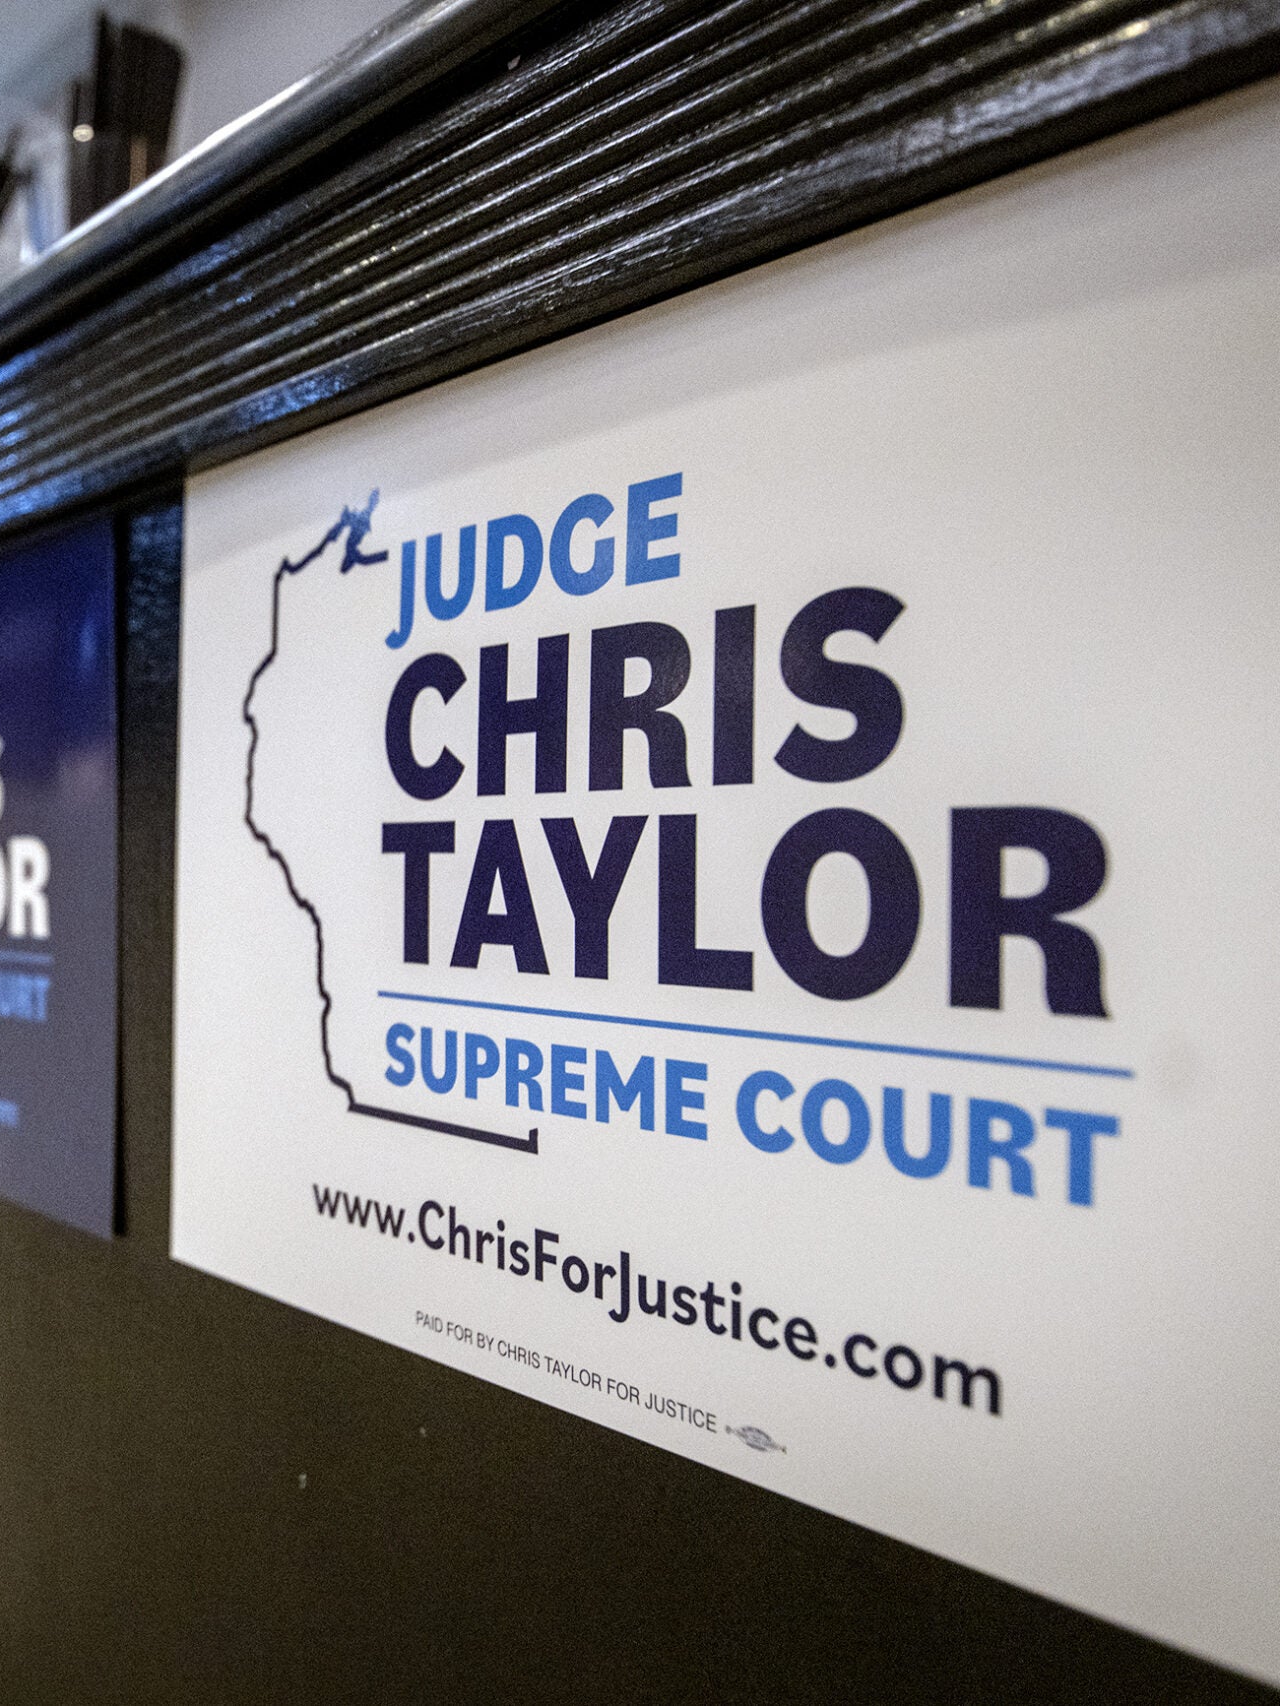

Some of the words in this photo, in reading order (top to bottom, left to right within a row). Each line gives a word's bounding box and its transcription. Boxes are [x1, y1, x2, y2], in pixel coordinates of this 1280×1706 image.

[384, 472, 684, 649] JUDGE
[384, 586, 907, 802] CHRIS
[381, 806, 1111, 1020] TAYLOR
[384, 1022, 709, 1142] SUPREME
[735, 1070, 1120, 1207] COURT
[312, 1183, 1003, 1417] www.ChrisForJustice.com
[415, 1310, 444, 1334] PAID
[447, 1321, 474, 1345] FOR
[476, 1332, 495, 1352] BY
[497, 1340, 541, 1369] CHRIS
[544, 1355, 602, 1392] TAYLOR
[607, 1378, 641, 1406] FOR
[644, 1393, 718, 1434] JUSTICE
